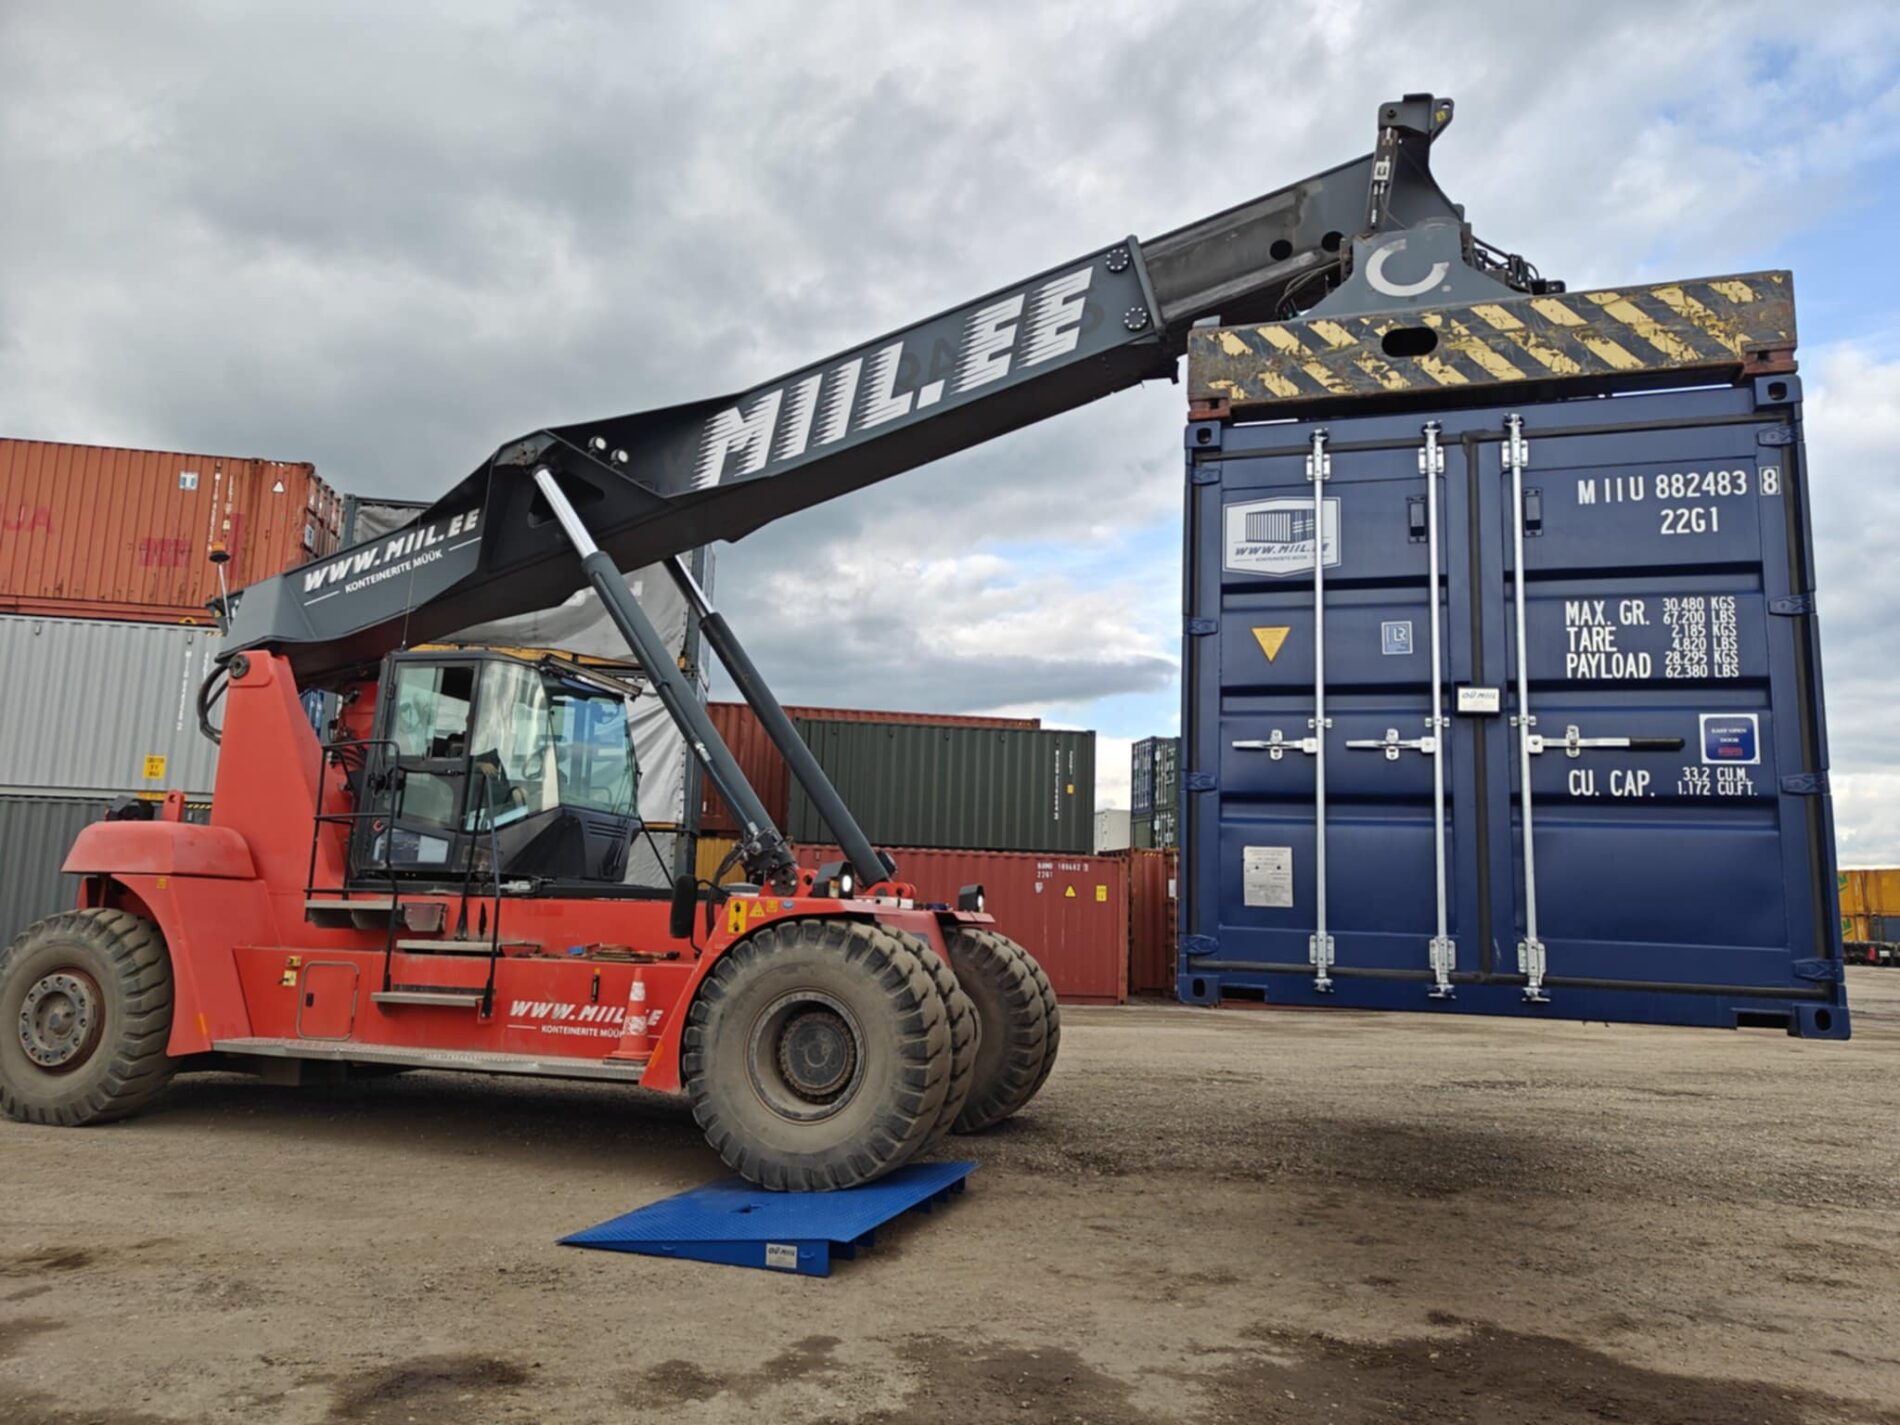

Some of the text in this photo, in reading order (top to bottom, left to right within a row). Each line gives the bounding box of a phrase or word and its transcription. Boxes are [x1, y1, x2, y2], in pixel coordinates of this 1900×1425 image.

[692, 266, 1094, 490] MIIL.EE
[1577, 468, 1778, 504] MIIU 882483 8
[1660, 507, 1718, 534] 22G1
[304, 508, 480, 593] WWW.MIIL.EE
[345, 549, 443, 595] KONTEINERITE MÜÜK
[1565, 596, 1736, 626] MAX. GR. 30.480 KGS
[1663, 609, 1736, 625] 67.200 LBS
[1566, 623, 1737, 652] TARE 2.185 KGS
[1671, 637, 1738, 652] 4.820 LBS
[1566, 650, 1739, 679] PAYLOAD 28.295 KGS
[1665, 664, 1740, 679] 62.380 LBS
[1568, 770, 1600, 796] CU.
[1609, 769, 1655, 797] CAP.
[1681, 767, 1710, 782] 33.2
[1677, 781, 1711, 796] 1.172
[509, 1000, 664, 1027] WWW.MIILE
[541, 1025, 598, 1037] KONTEINERITE
